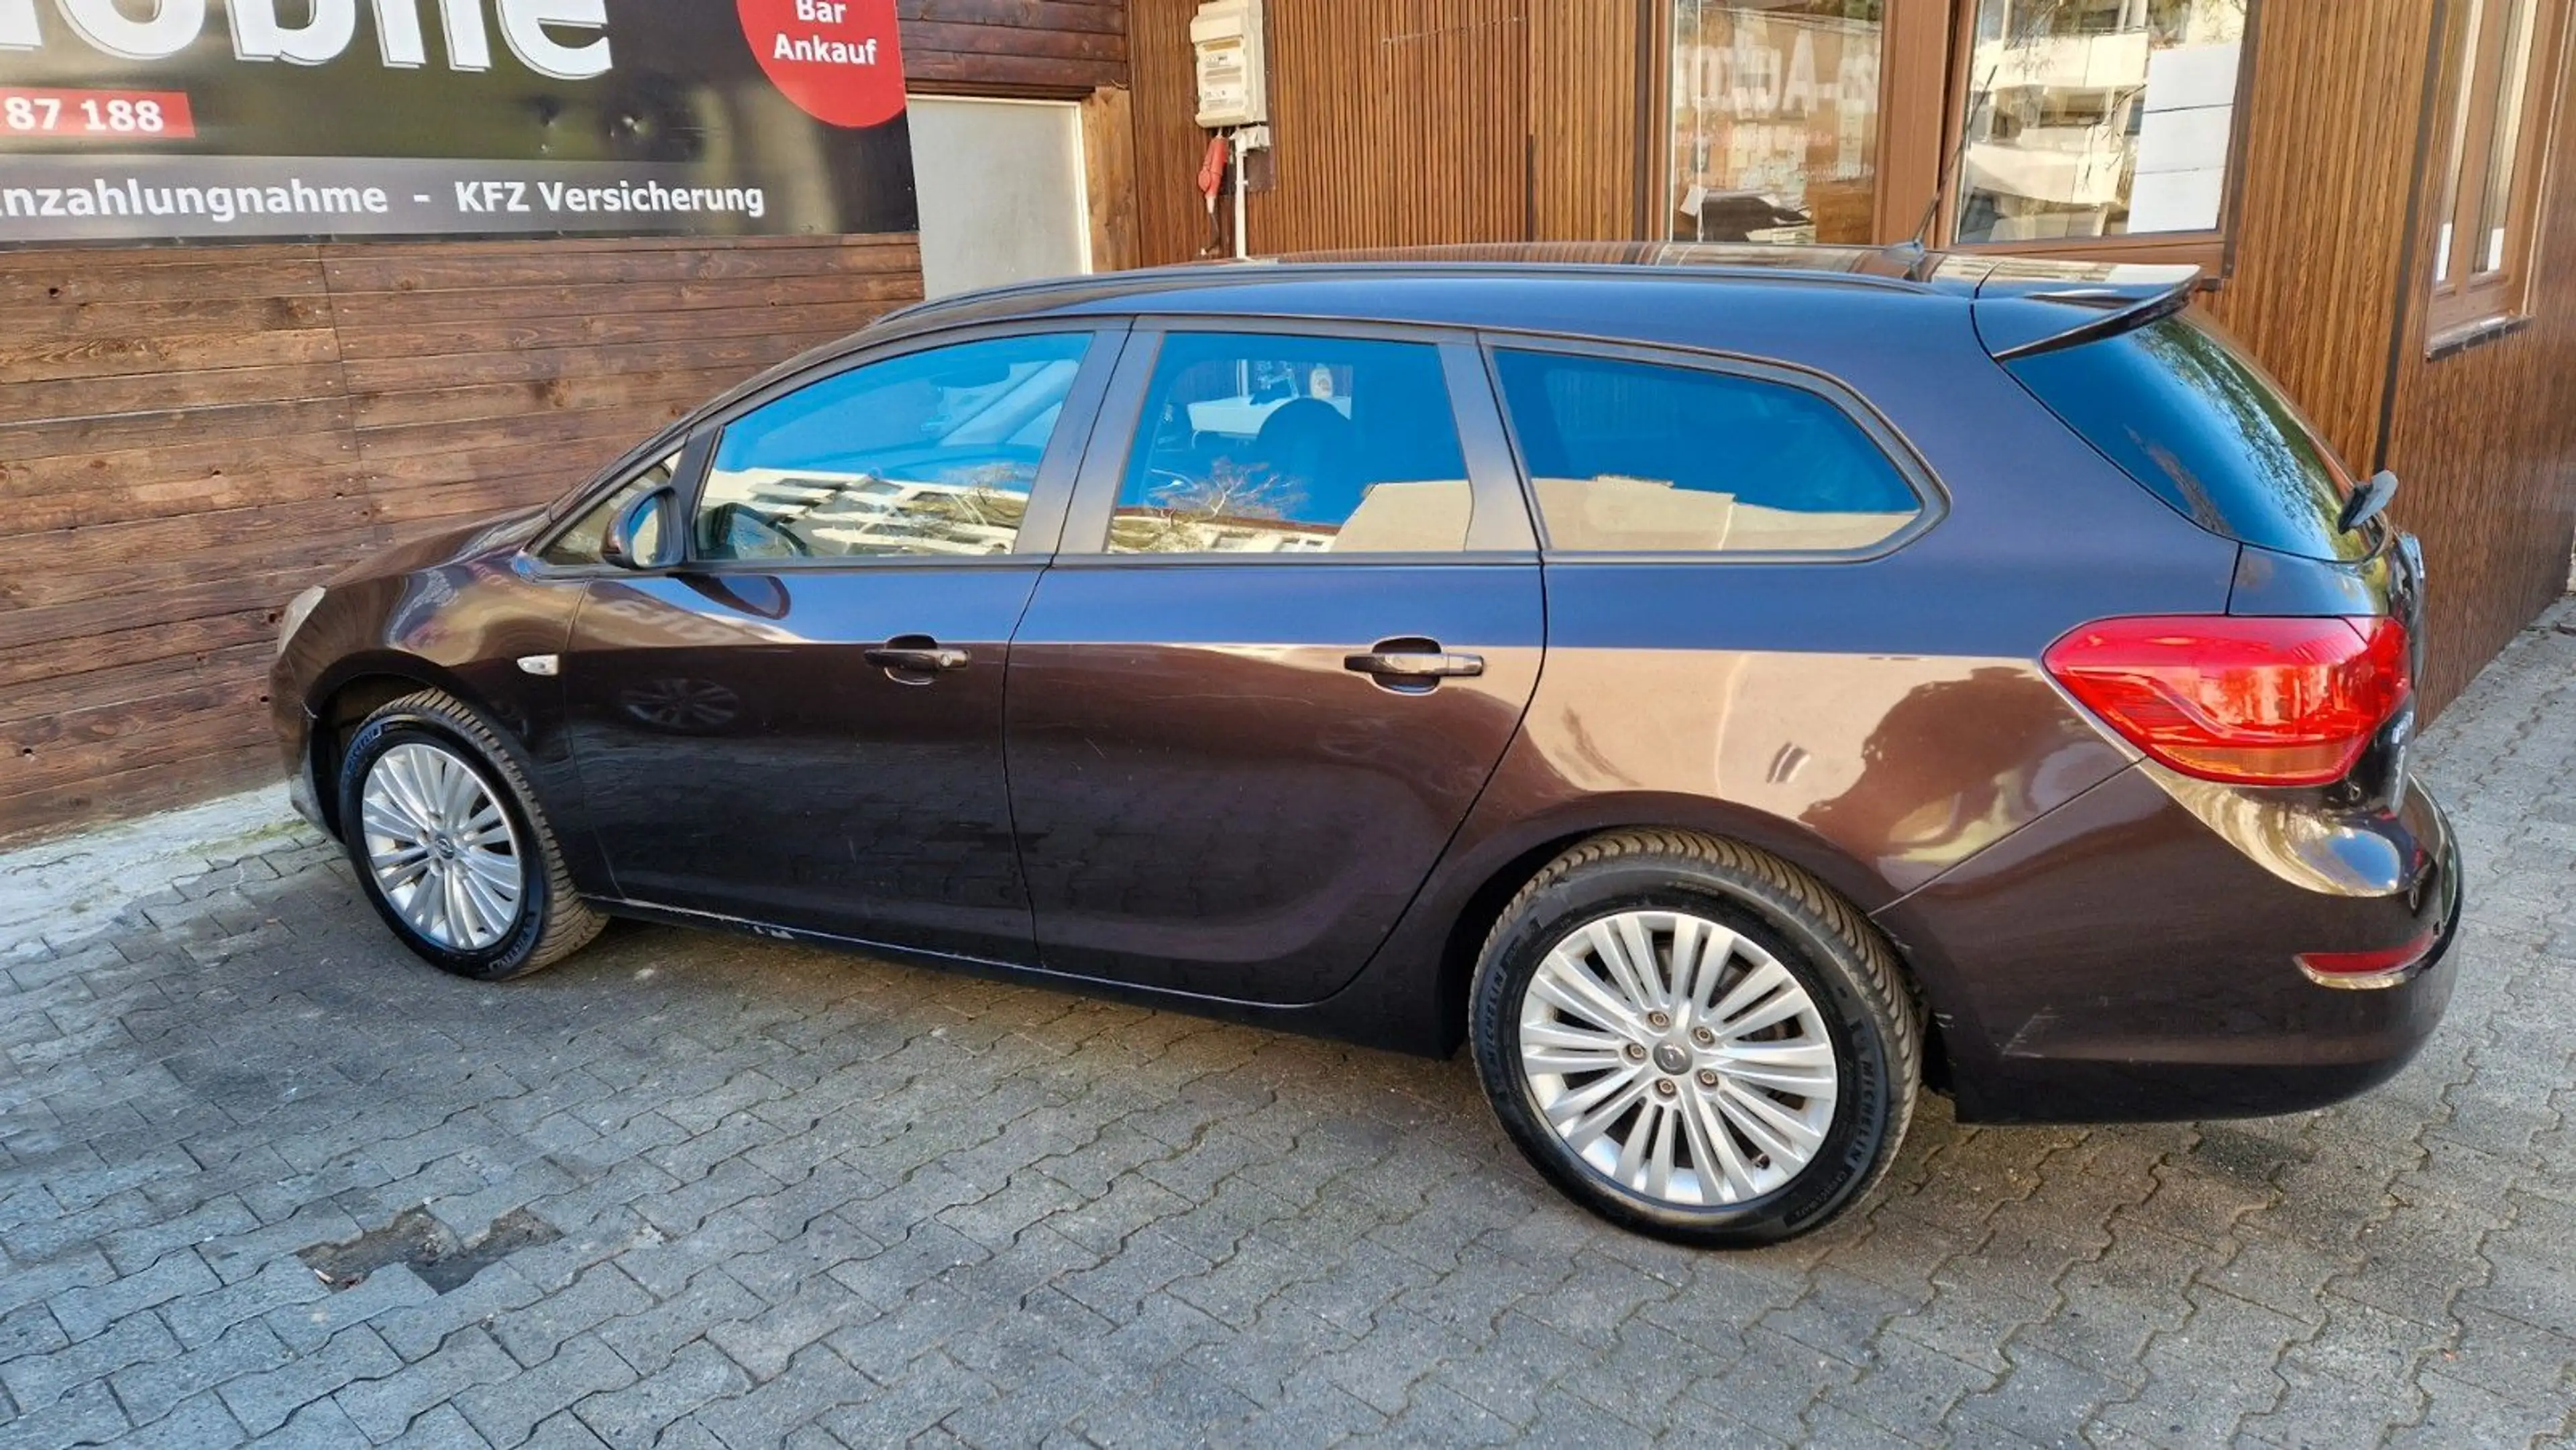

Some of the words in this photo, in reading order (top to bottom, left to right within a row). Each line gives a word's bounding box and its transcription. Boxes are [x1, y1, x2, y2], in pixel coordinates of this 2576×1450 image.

[796, 0, 846, 23] Bar
[773, 34, 876, 64] Ankauf
[81, 99, 164, 132] 188
[0, 178, 388, 223] nzahlungnahme
[454, 181, 530, 212] KFZ
[537, 180, 765, 217] Versicherung
[1849, 1059, 1876, 1162] MICHELIN
